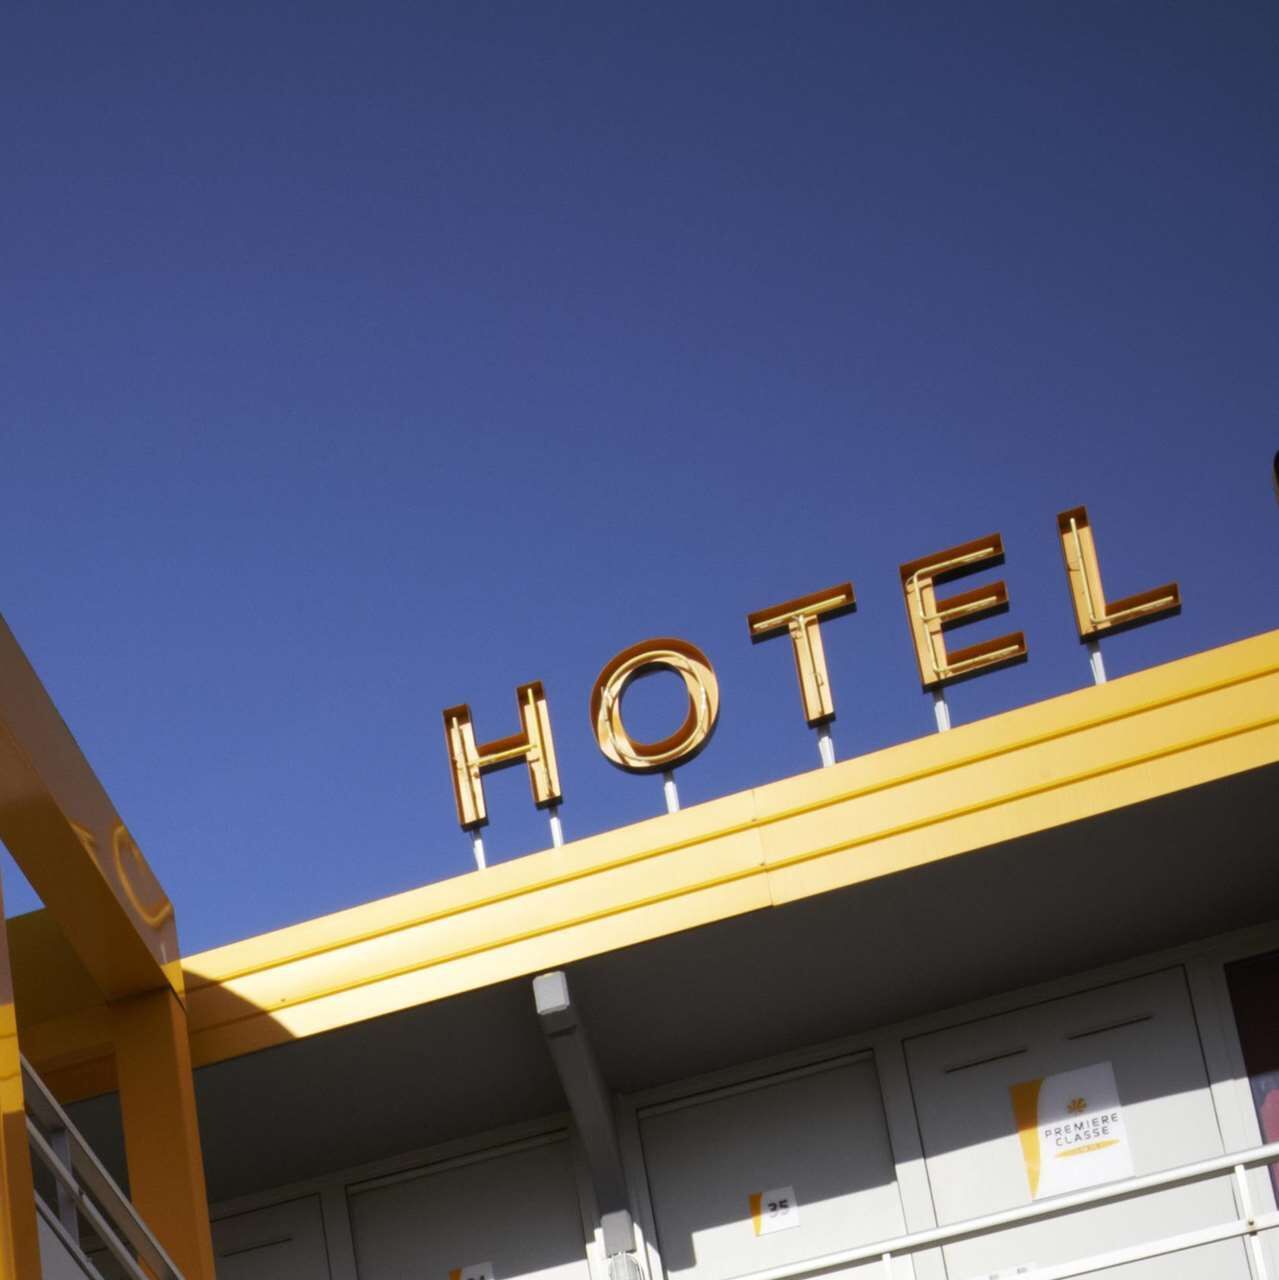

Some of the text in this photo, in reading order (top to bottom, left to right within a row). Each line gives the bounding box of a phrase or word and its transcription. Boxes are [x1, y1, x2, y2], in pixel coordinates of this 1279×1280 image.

[442, 505, 1182, 831] HOTEL
[1044, 1112, 1120, 1138] PREMIERE
[1055, 1125, 1110, 1147] CLASSE
[767, 1198, 790, 1217] 35
